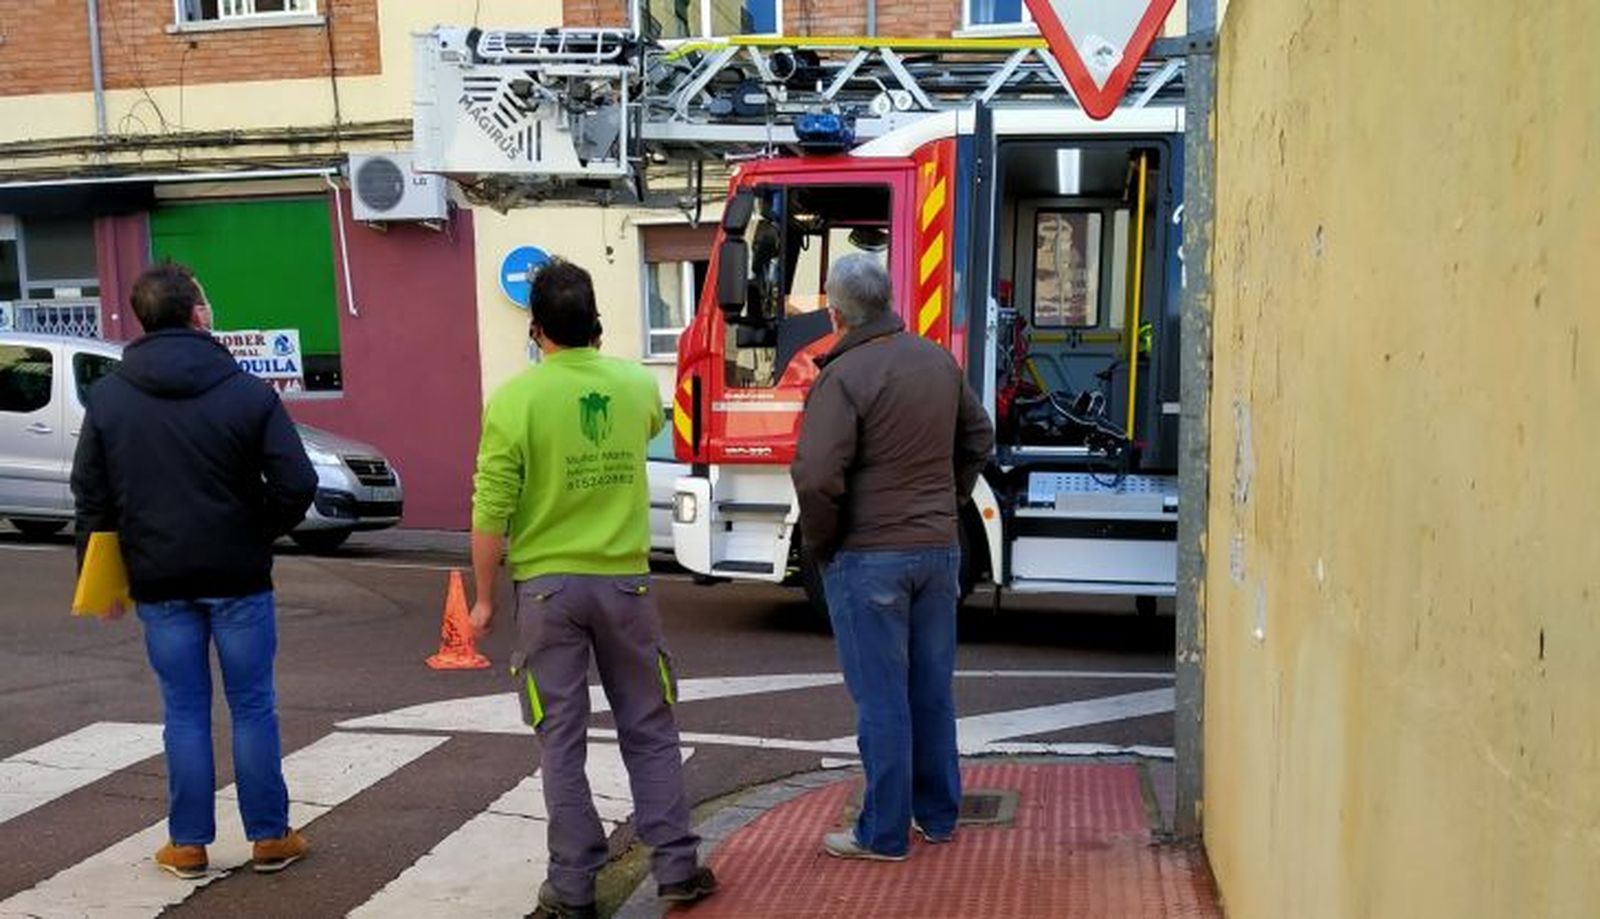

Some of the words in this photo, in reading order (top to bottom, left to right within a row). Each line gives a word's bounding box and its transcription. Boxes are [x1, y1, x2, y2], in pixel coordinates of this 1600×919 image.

[458, 94, 520, 160] MAGIRUS
[412, 177, 427, 186] LG
[239, 359, 297, 374] QUILA
